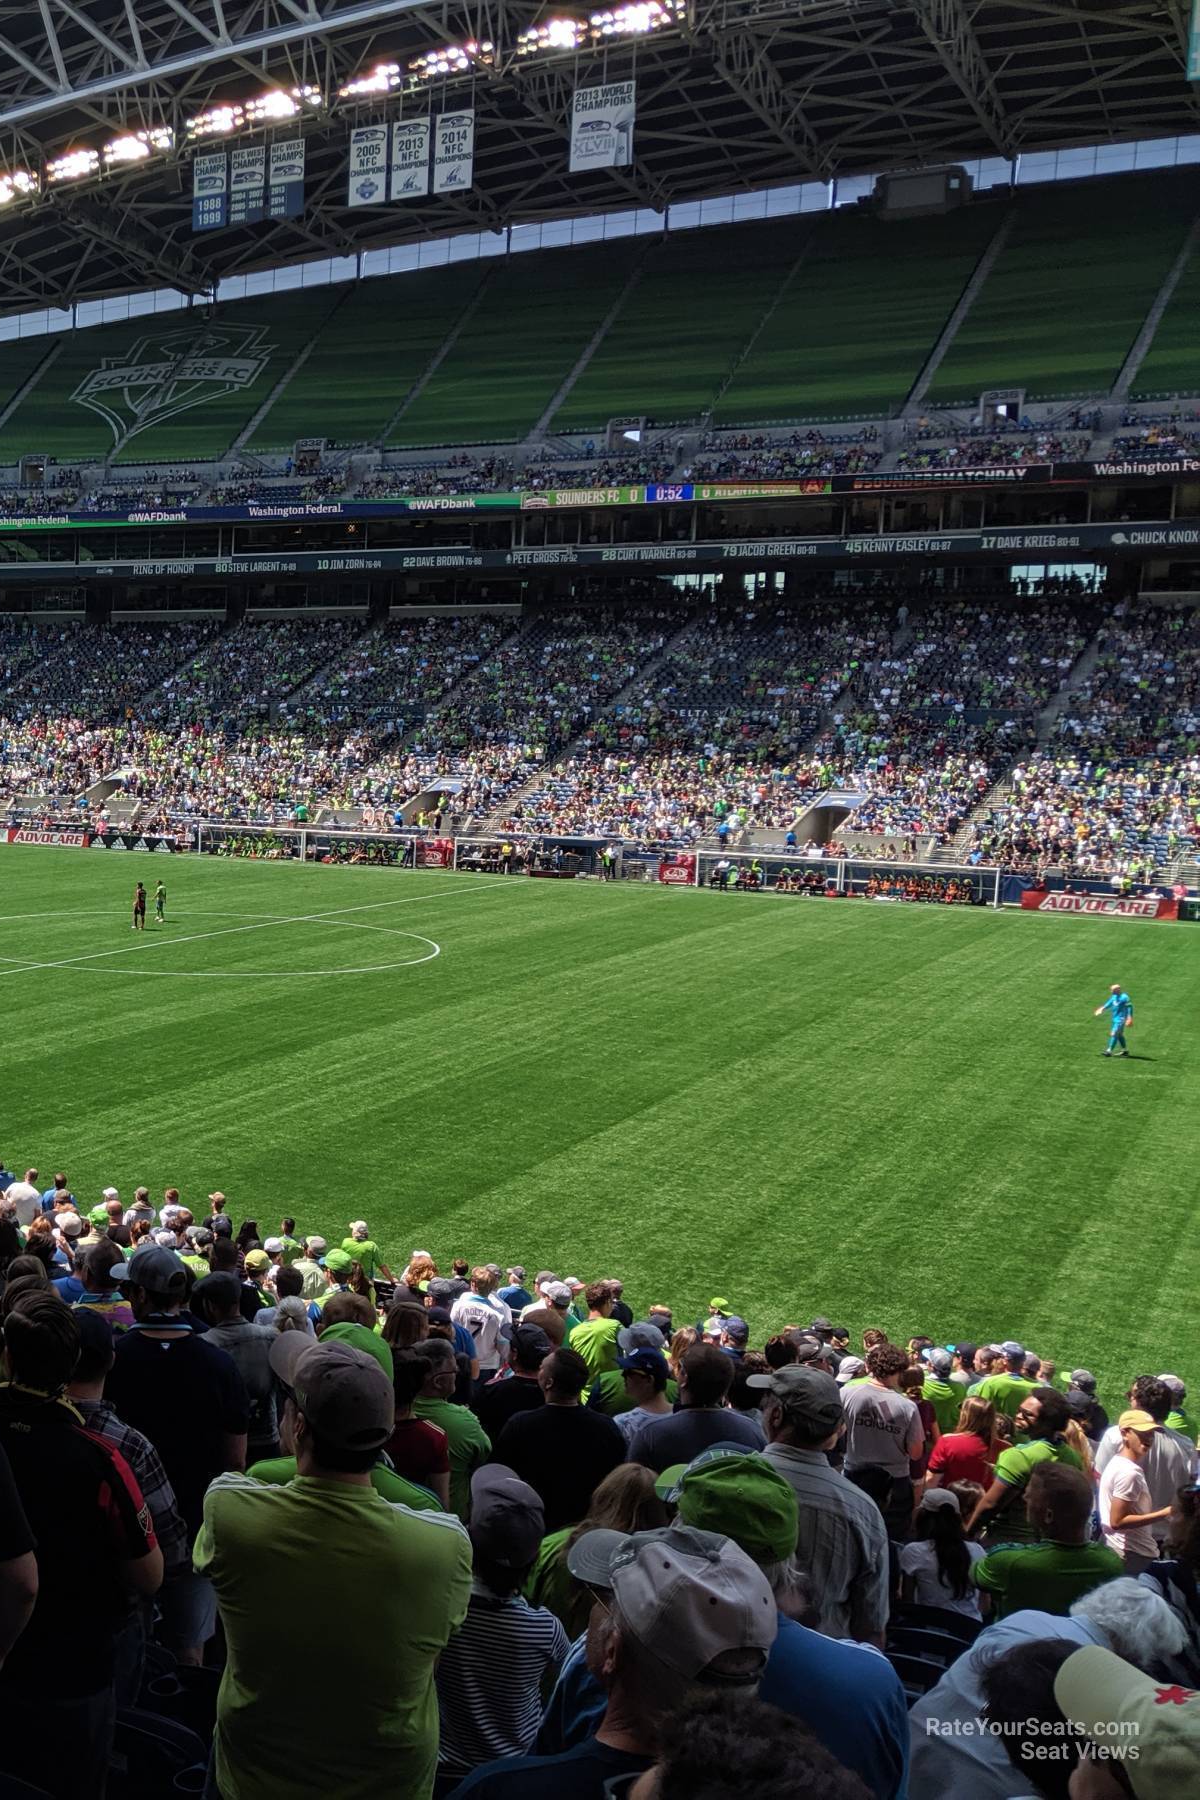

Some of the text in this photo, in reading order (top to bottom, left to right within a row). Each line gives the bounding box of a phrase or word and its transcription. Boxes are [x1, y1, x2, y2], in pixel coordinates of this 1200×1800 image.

[575, 83, 633, 103] 2013 WORLD
[574, 94, 633, 113] CHAMPIONS
[441, 130, 467, 145] 2014
[286, 141, 304, 151] WEST
[356, 144, 381, 158] 2005
[398, 137, 424, 152] 2013
[444, 143, 463, 154] NFC
[271, 150, 304, 164] CHAMPS
[359, 156, 377, 168] NFC
[401, 150, 419, 162] NFC
[435, 152, 473, 165] CHAMPIONS
[195, 163, 226, 177] CHAMPS
[232, 157, 264, 170] CHAMPS
[392, 159, 429, 172] CHAMPIONS
[351, 165, 385, 178] CHAMPIONS
[198, 198, 221, 211] 1988
[198, 211, 221, 225] 1999
[220, 368, 250, 379] FC
[1094, 461, 1180, 476] Washington
[556, 490, 606, 505] SOUNDERS
[607, 489, 620, 503] FC
[630, 488, 638, 502] 0
[656, 486, 684, 501] 0:52
[248, 505, 304, 517] Washington
[408, 498, 476, 511] @WAFDbank
[128, 511, 187, 523] @WAFDbank
[981, 537, 996, 549] 17
[997, 536, 1023, 548] DAVE
[1023, 535, 1056, 548] KRIEG
[1130, 530, 1199, 545] CHUCK KNOX
[722, 546, 737, 557] 79
[737, 545, 765, 557] JACOB
[767, 544, 796, 556] GREEN
[845, 541, 862, 553] 45
[863, 540, 894, 552] KENNY
[896, 539, 930, 551] EASLEY
[402, 557, 416, 567] 22
[416, 556, 436, 567] DAVE
[436, 555, 464, 566] BROWN
[512, 552, 531, 564] PETE
[533, 552, 560, 563] GROSS
[602, 550, 616, 561] 28
[617, 549, 639, 560] CURT
[640, 548, 676, 560] WARNER
[133, 563, 194, 575] RING OF HONOR
[215, 563, 227, 573] 80
[228, 562, 249, 573] STEVE
[250, 561, 280, 572] LARGENT
[317, 560, 329, 569] 10
[329, 559, 344, 569] JIM
[345, 558, 365, 569] ZORN
[14, 830, 84, 847] ADVOCARE
[1042, 895, 1158, 916] ADVOCARE
[470, 1319, 483, 1337] 7
[855, 1412, 901, 1434] adidas
